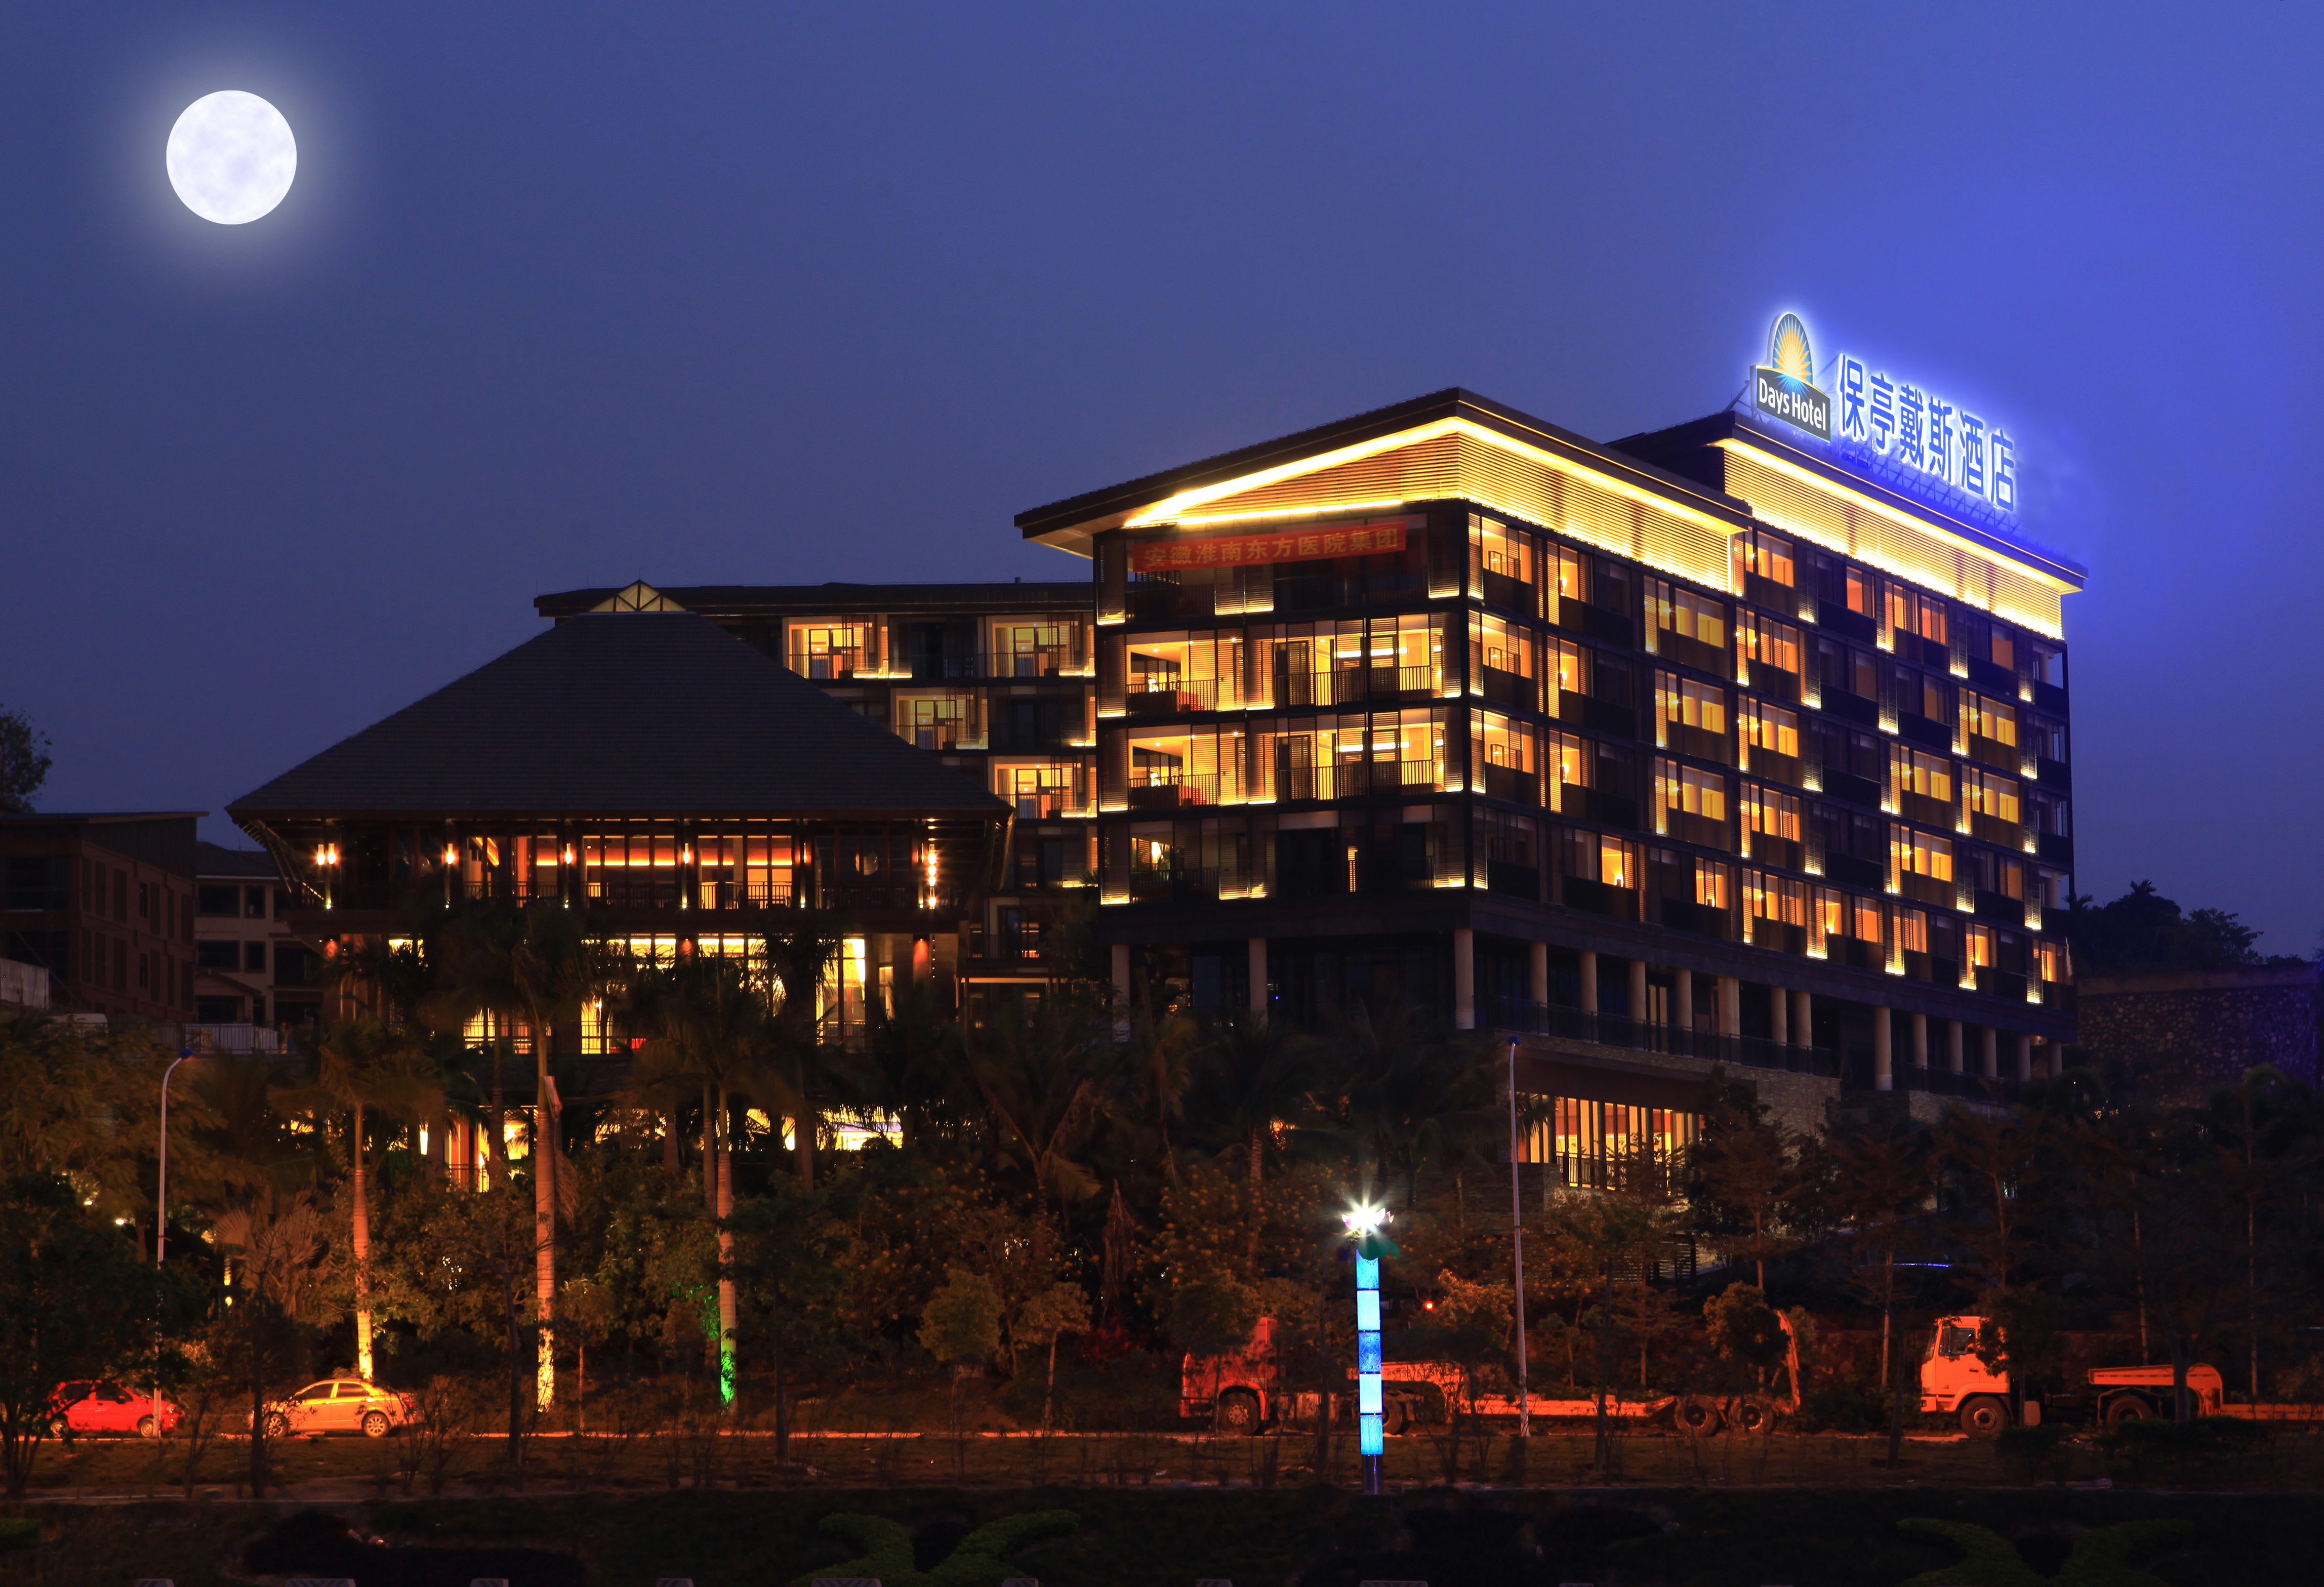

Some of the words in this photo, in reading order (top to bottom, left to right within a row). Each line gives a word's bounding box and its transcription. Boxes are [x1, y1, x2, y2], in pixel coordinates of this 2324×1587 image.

[1759, 378, 1789, 415] Days
[1792, 391, 1826, 431] Hotel
[1840, 354, 2014, 512] 保亭戴斯酒店
[1146, 528, 1398, 566] 安徽淮南东方医院集团
